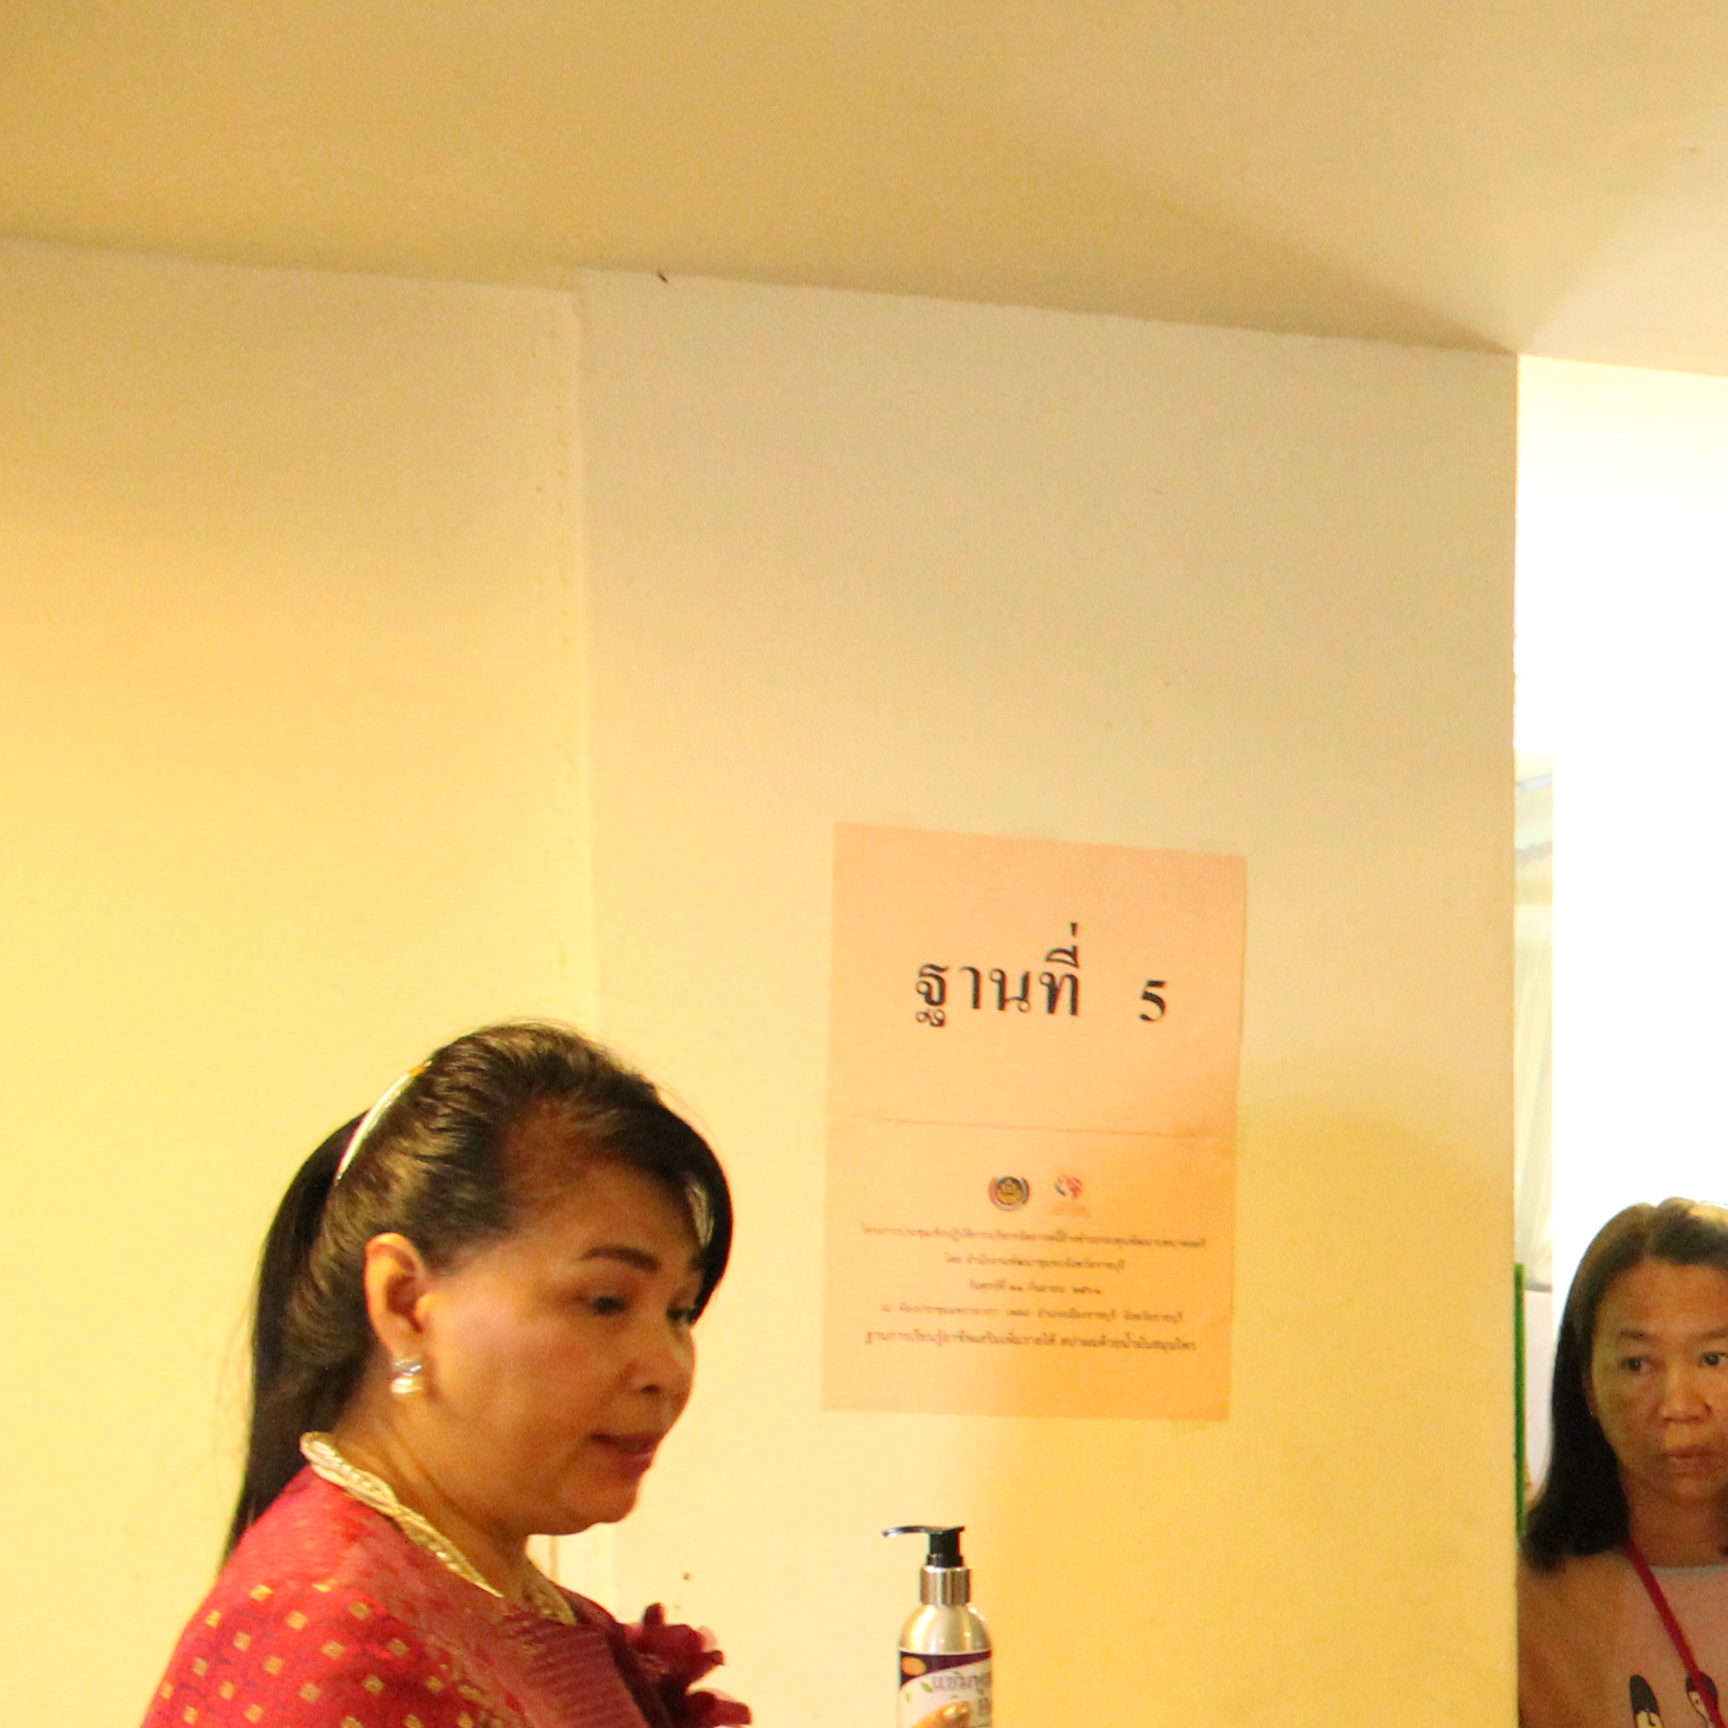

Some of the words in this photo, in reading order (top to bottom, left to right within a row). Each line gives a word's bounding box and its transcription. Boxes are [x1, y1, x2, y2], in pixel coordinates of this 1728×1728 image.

[915, 921, 1080, 1028] ฐานที่
[1138, 979, 1168, 1023] 5
